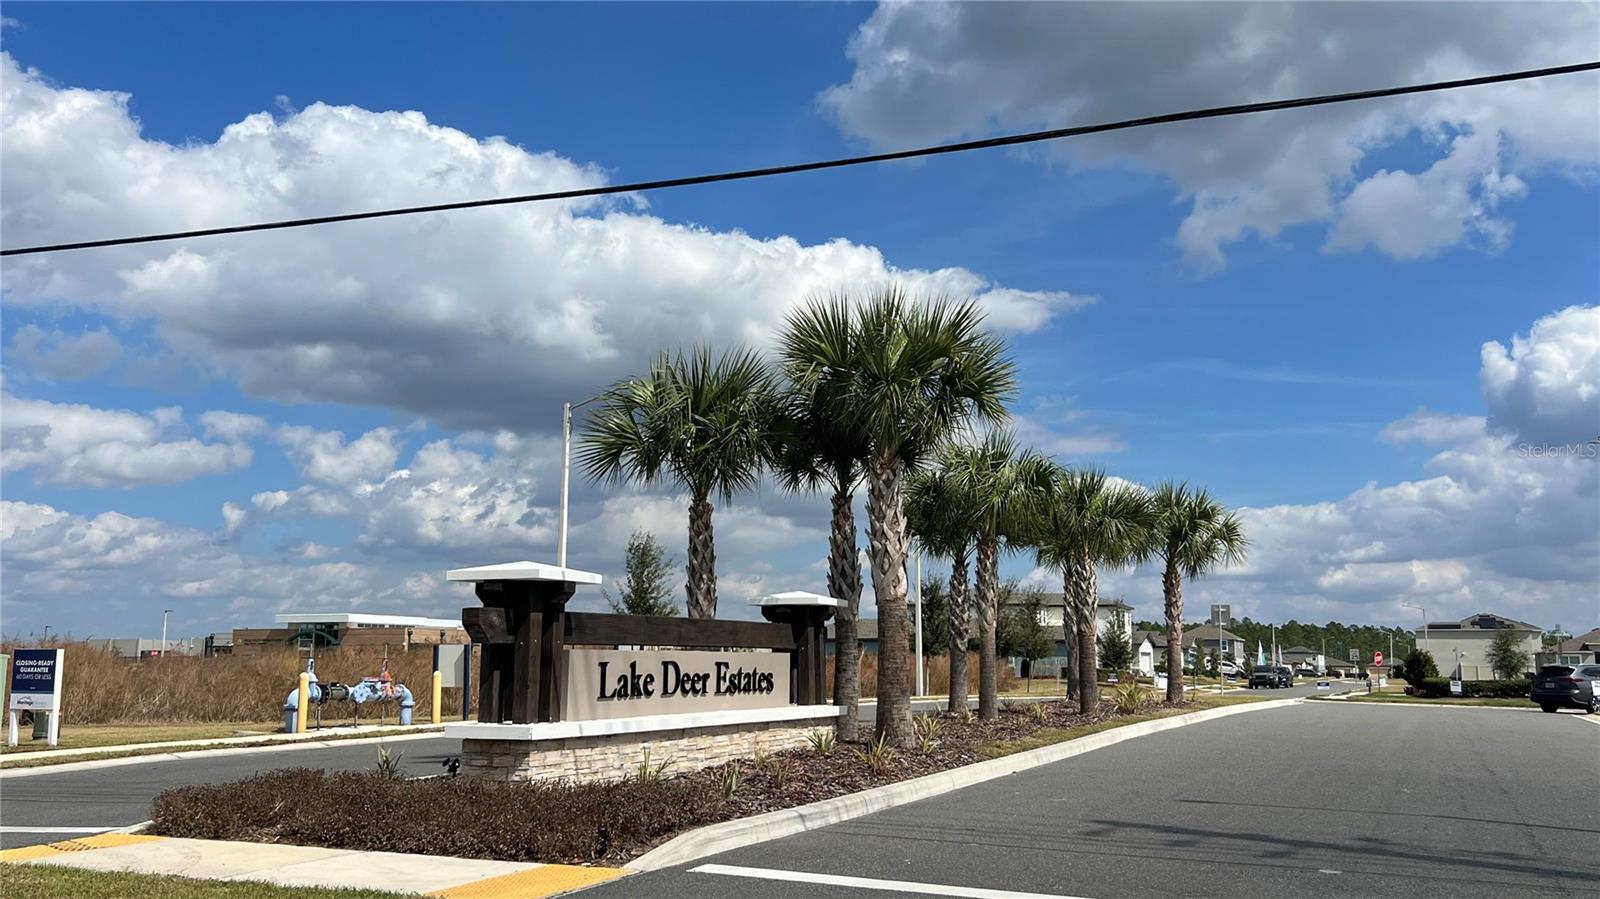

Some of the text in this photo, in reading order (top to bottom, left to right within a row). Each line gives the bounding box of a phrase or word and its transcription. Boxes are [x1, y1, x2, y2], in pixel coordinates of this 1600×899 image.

[597, 660, 774, 701] Lake Deer Estates
